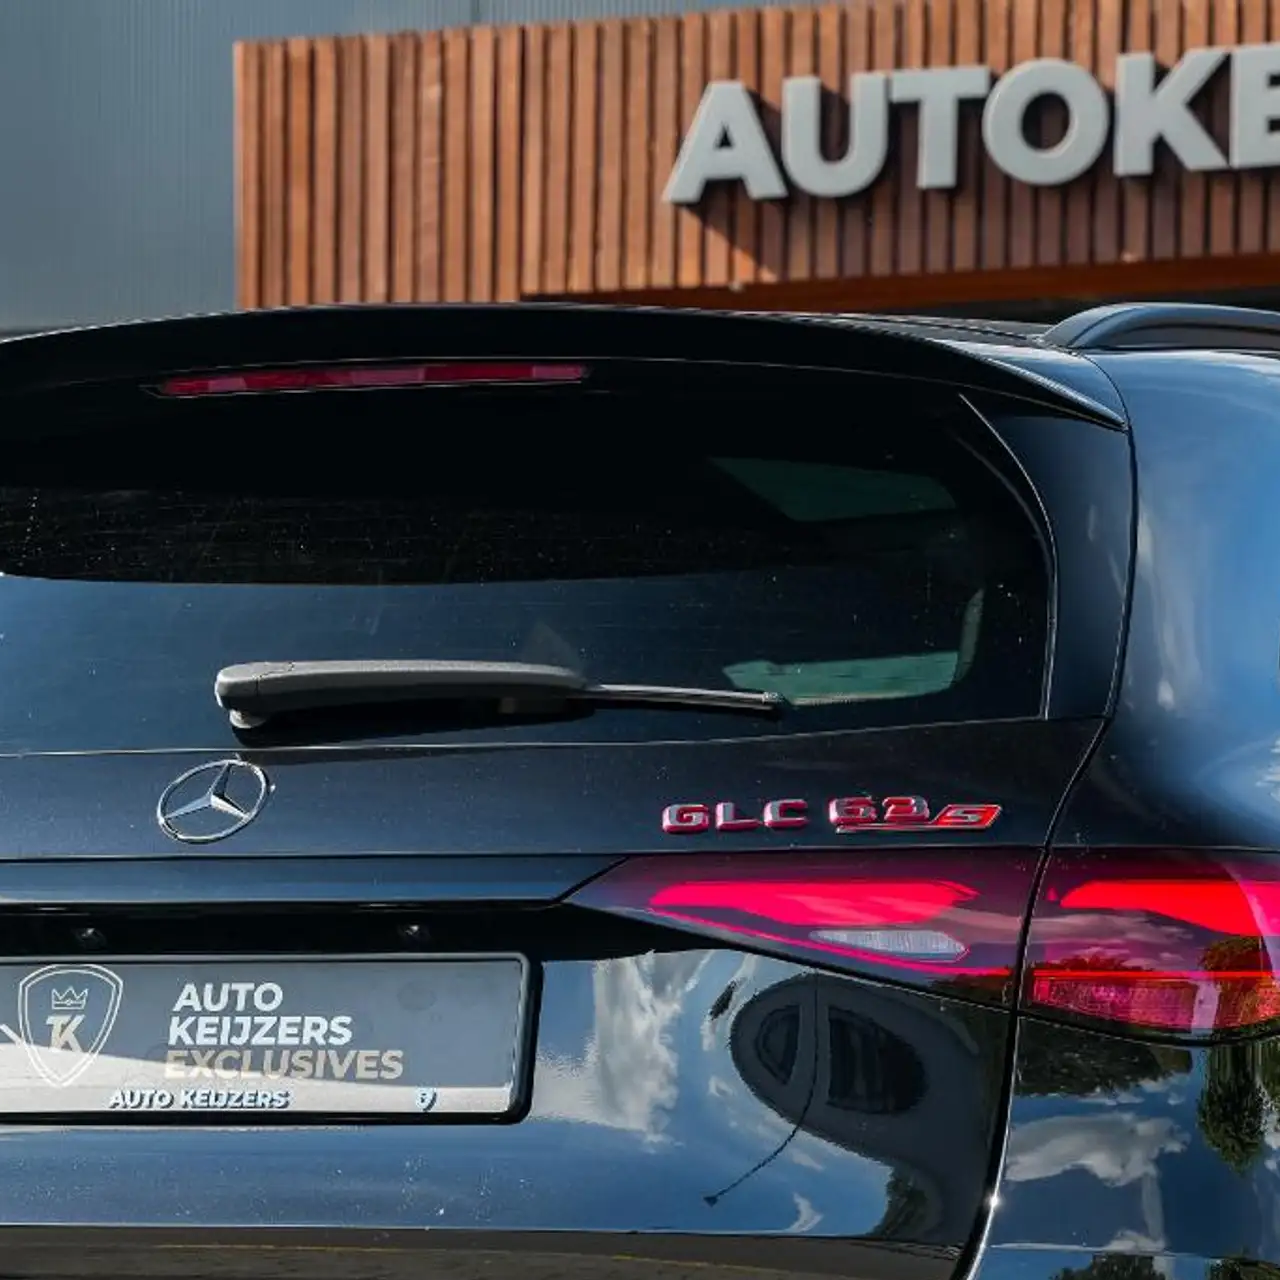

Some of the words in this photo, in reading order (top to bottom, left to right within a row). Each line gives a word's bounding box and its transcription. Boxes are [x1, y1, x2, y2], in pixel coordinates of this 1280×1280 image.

[661, 799, 809, 834] GLC
[172, 982, 284, 1012] AUTO
[168, 1015, 353, 1046] KEIJZERS
[164, 1049, 404, 1080] EXCLUSIVES
[109, 1089, 174, 1109] AUTO
